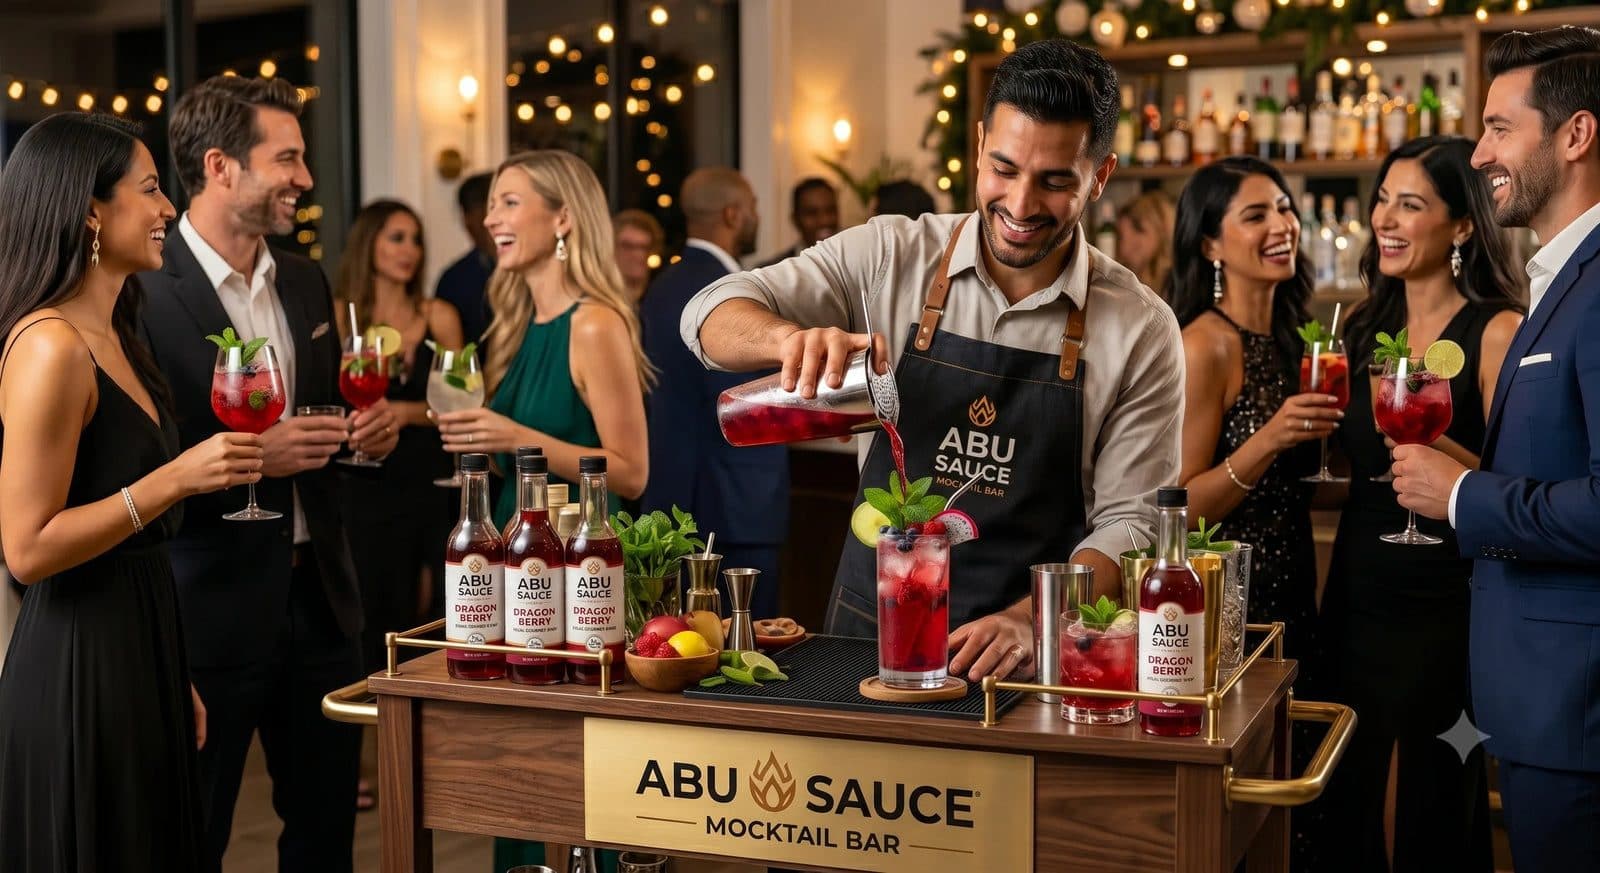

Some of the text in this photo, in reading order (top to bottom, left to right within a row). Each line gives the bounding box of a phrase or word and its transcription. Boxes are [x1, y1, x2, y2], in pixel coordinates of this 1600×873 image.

[938, 426, 1016, 463] ABU
[934, 454, 1012, 485] SAUCE
[936, 476, 1005, 498] MOCIL BAR
[459, 574, 492, 587] ABU
[518, 577, 551, 590] ABU
[577, 576, 611, 589] ABU
[458, 587, 493, 596] SAUCE
[517, 591, 552, 600] SAUCE
[577, 590, 611, 599] SAUCE
[455, 604, 497, 613] DRAGON
[513, 607, 555, 617] DRAGON
[573, 606, 616, 615] DRAGON
[460, 613, 493, 622] BERRY
[518, 617, 551, 626] BERRY
[578, 616, 611, 625] BERRY
[1152, 624, 1188, 637] ABU
[1152, 638, 1189, 647] SAUCE
[1148, 655, 1193, 666] DRAGON
[1152, 666, 1188, 676] BERRY
[635, 759, 974, 829] ABU SAUCE
[706, 815, 900, 855] MOCKTAIL BAR
